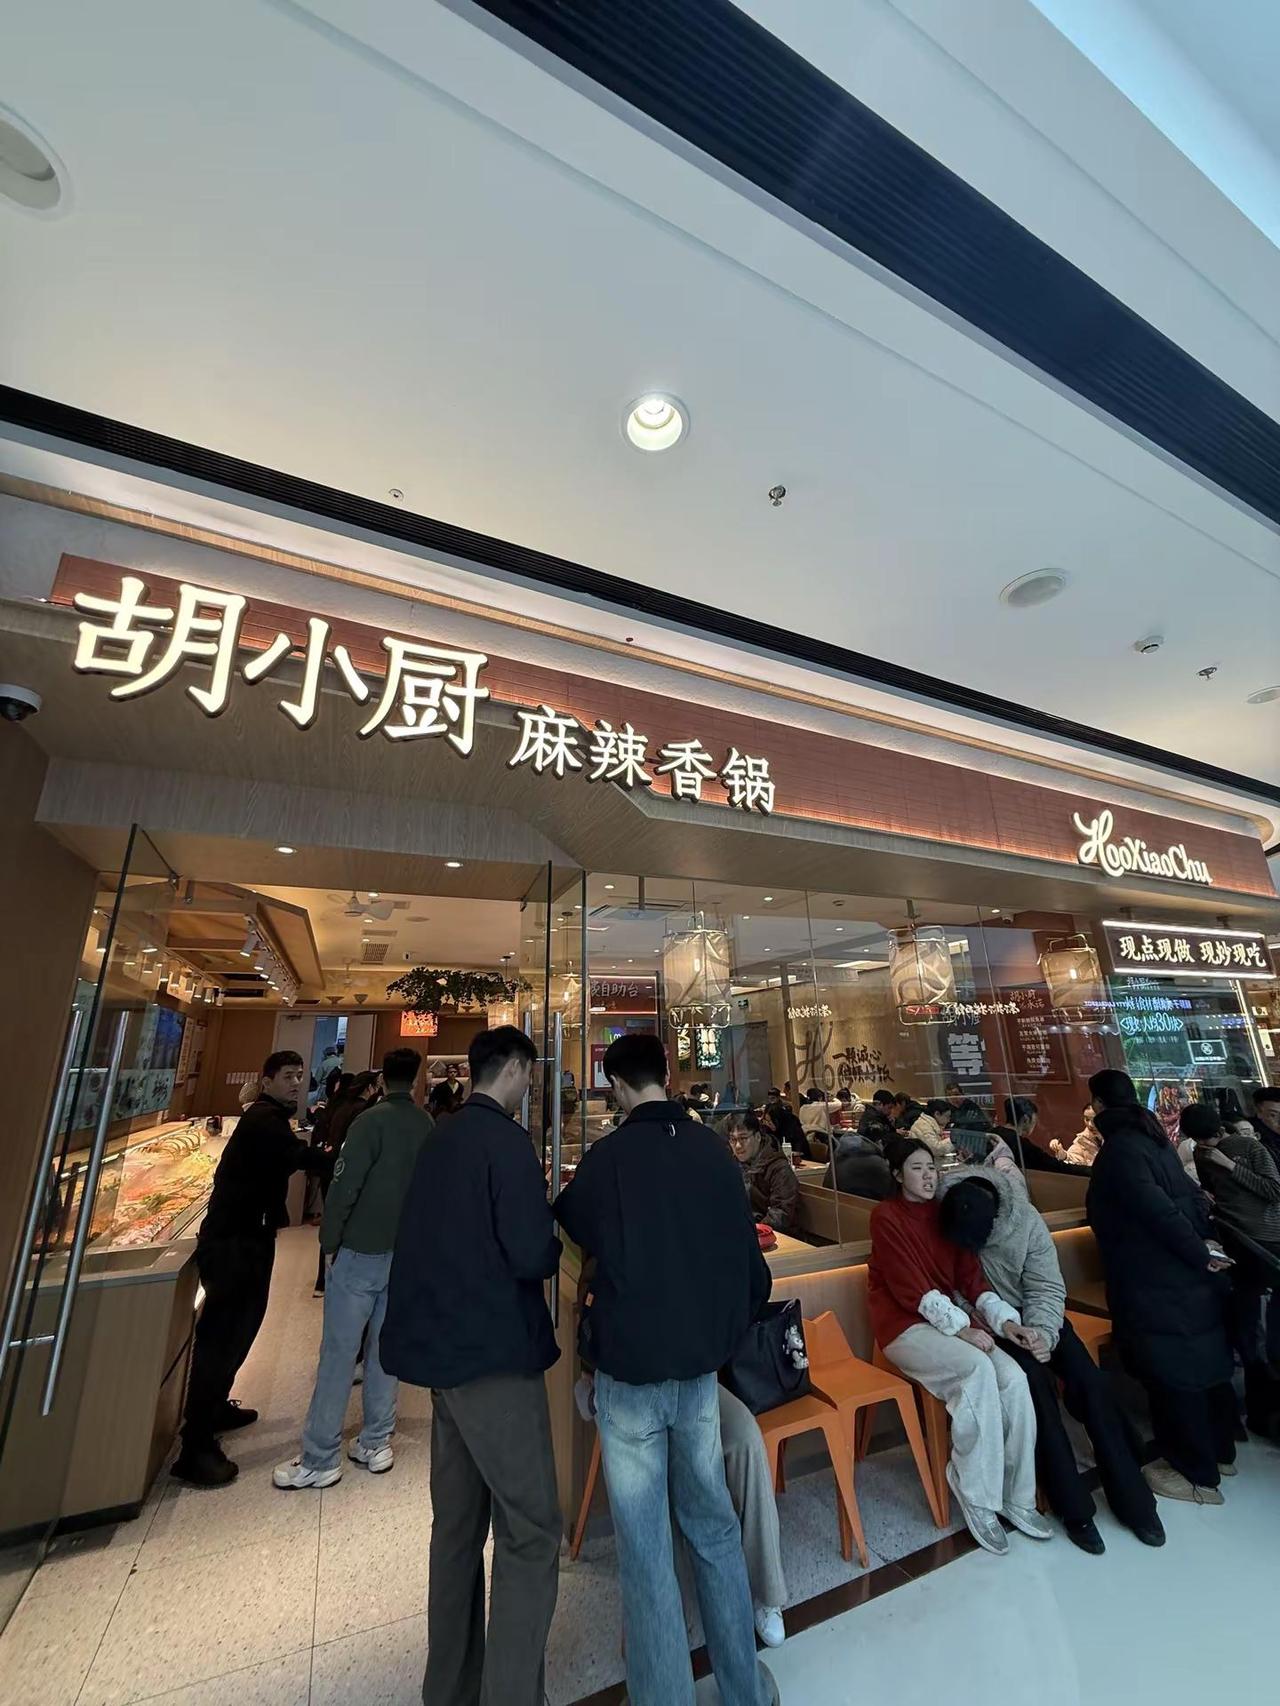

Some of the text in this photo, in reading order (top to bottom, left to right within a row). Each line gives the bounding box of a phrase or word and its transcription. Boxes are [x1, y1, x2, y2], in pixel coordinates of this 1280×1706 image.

[74, 577, 775, 815] 胡小厨 麻辣香锅
[1073, 810, 1212, 884] HooXiaoChu
[1119, 935, 1267, 968] 现点现做 现炒现吃
[948, 1033, 985, 1076] 等
